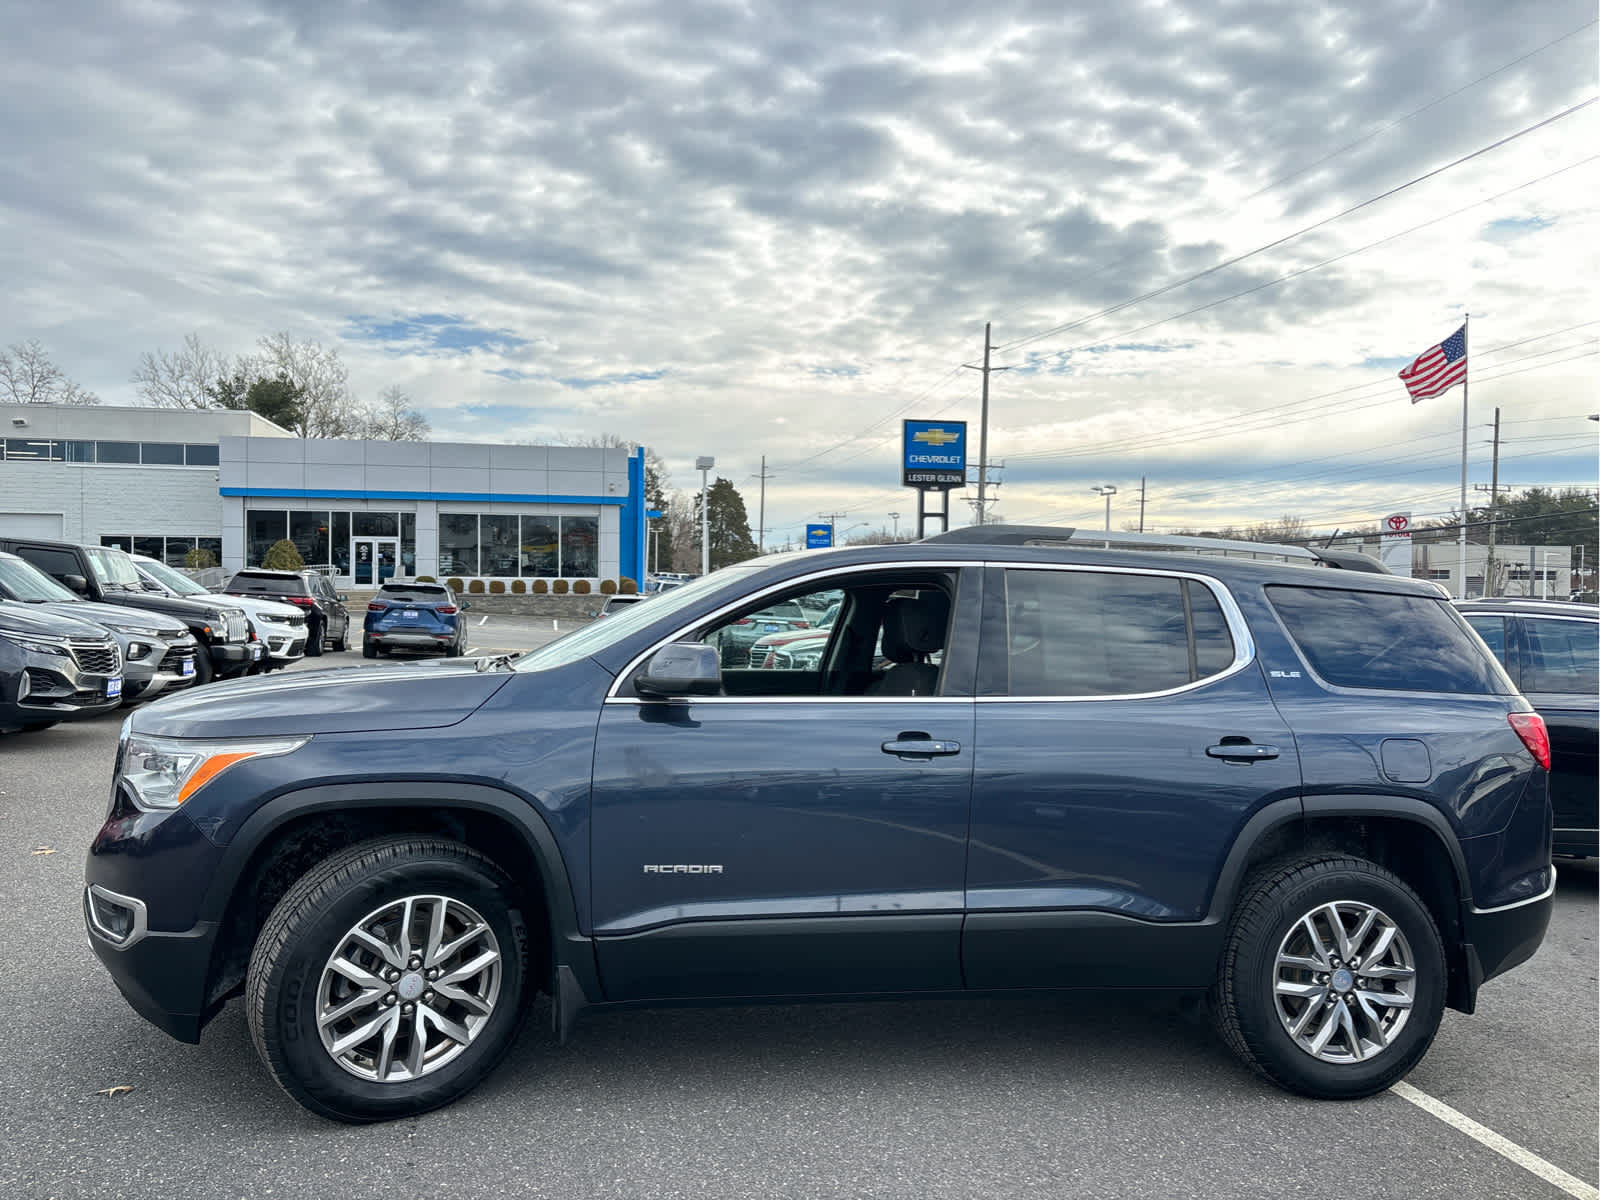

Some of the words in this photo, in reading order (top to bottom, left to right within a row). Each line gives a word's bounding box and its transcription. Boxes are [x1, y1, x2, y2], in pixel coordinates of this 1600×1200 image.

[909, 455, 961, 464] CHEVROLET
[908, 474, 936, 482] LESTER
[937, 474, 962, 482] GLENN
[643, 864, 723, 873] ACADIA
